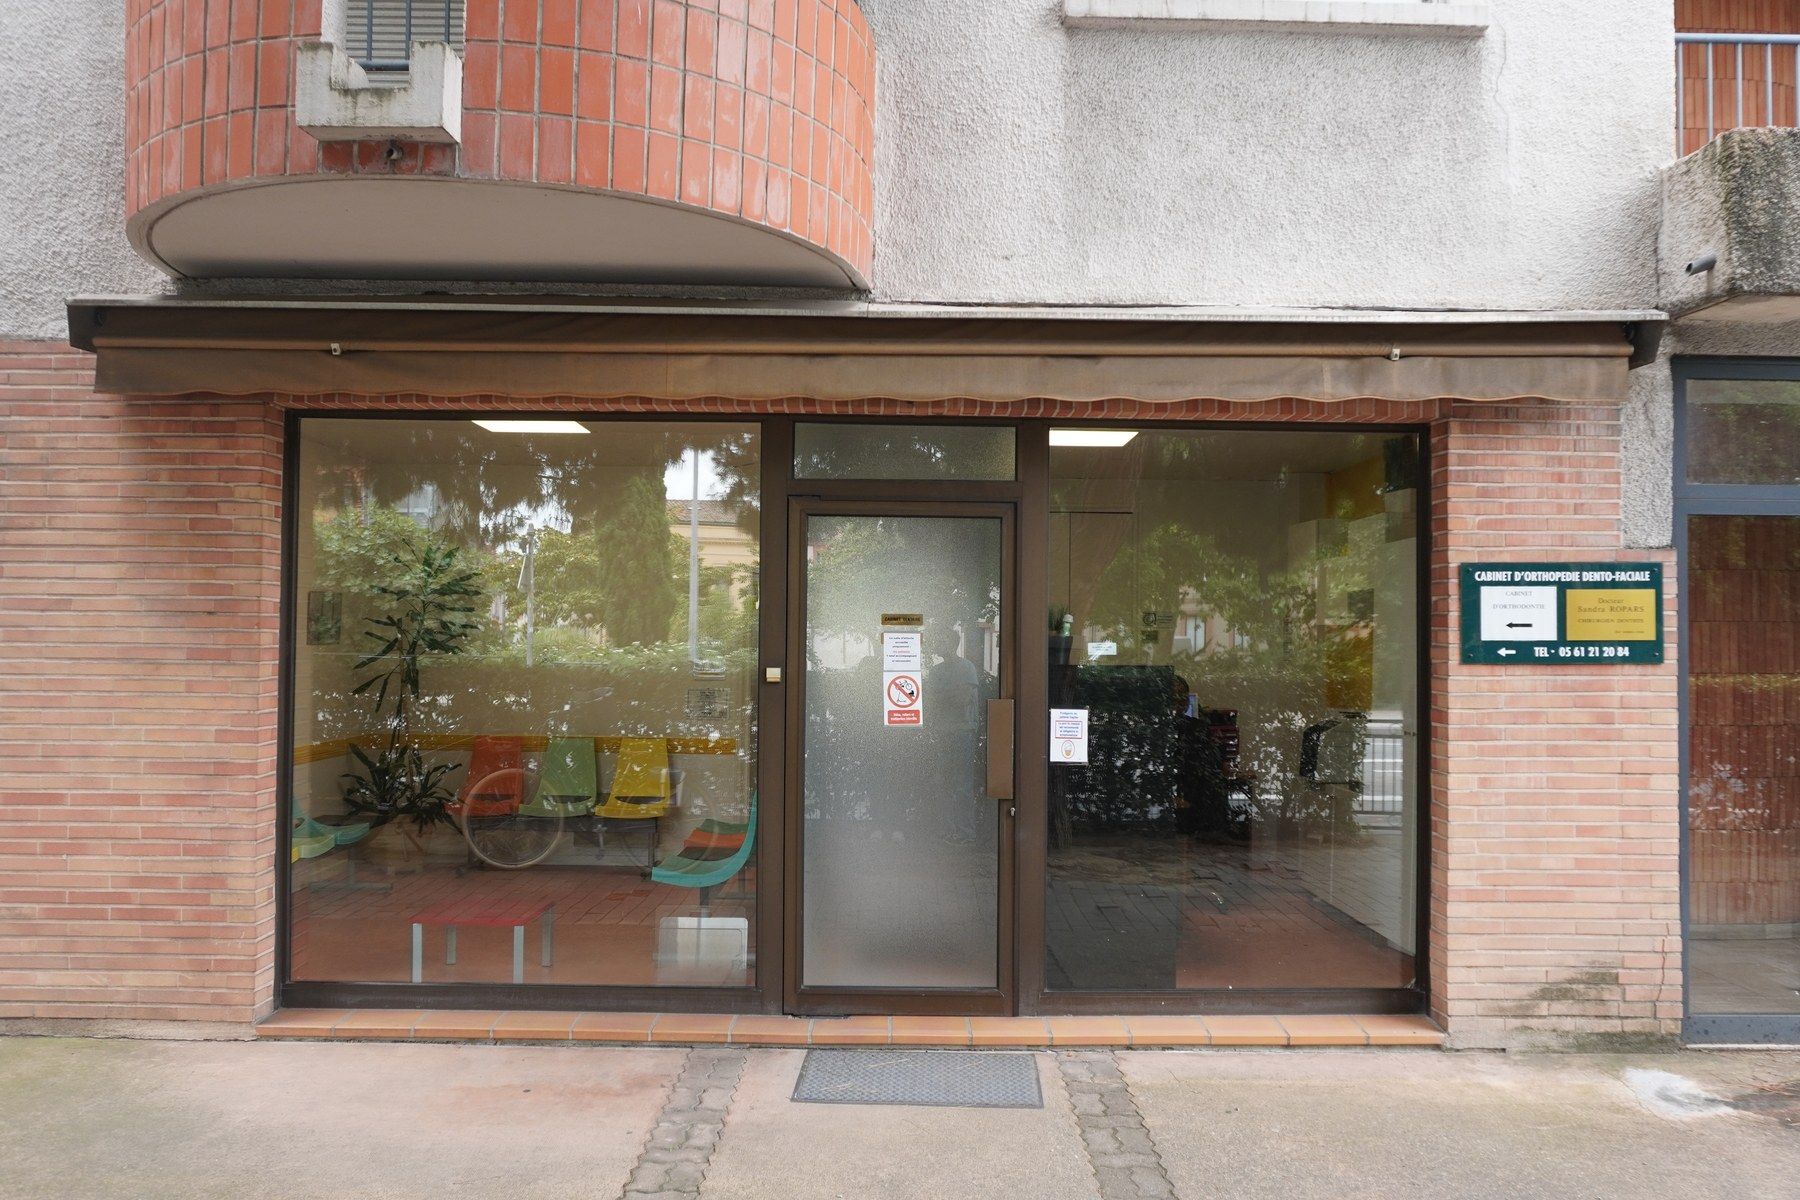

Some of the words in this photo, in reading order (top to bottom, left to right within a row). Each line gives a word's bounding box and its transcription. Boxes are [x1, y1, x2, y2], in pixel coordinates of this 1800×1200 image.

[1474, 571, 1512, 582] CABINET
[1514, 571, 1580, 582] D'ORTHOPEDIE
[1583, 571, 1650, 582] DENTO-FACIALE
[1559, 647, 1572, 657] 05
[1573, 647, 1585, 657] 61
[1588, 647, 1600, 657] 21
[1602, 647, 1615, 657] 20
[1616, 646, 1629, 657] 84
